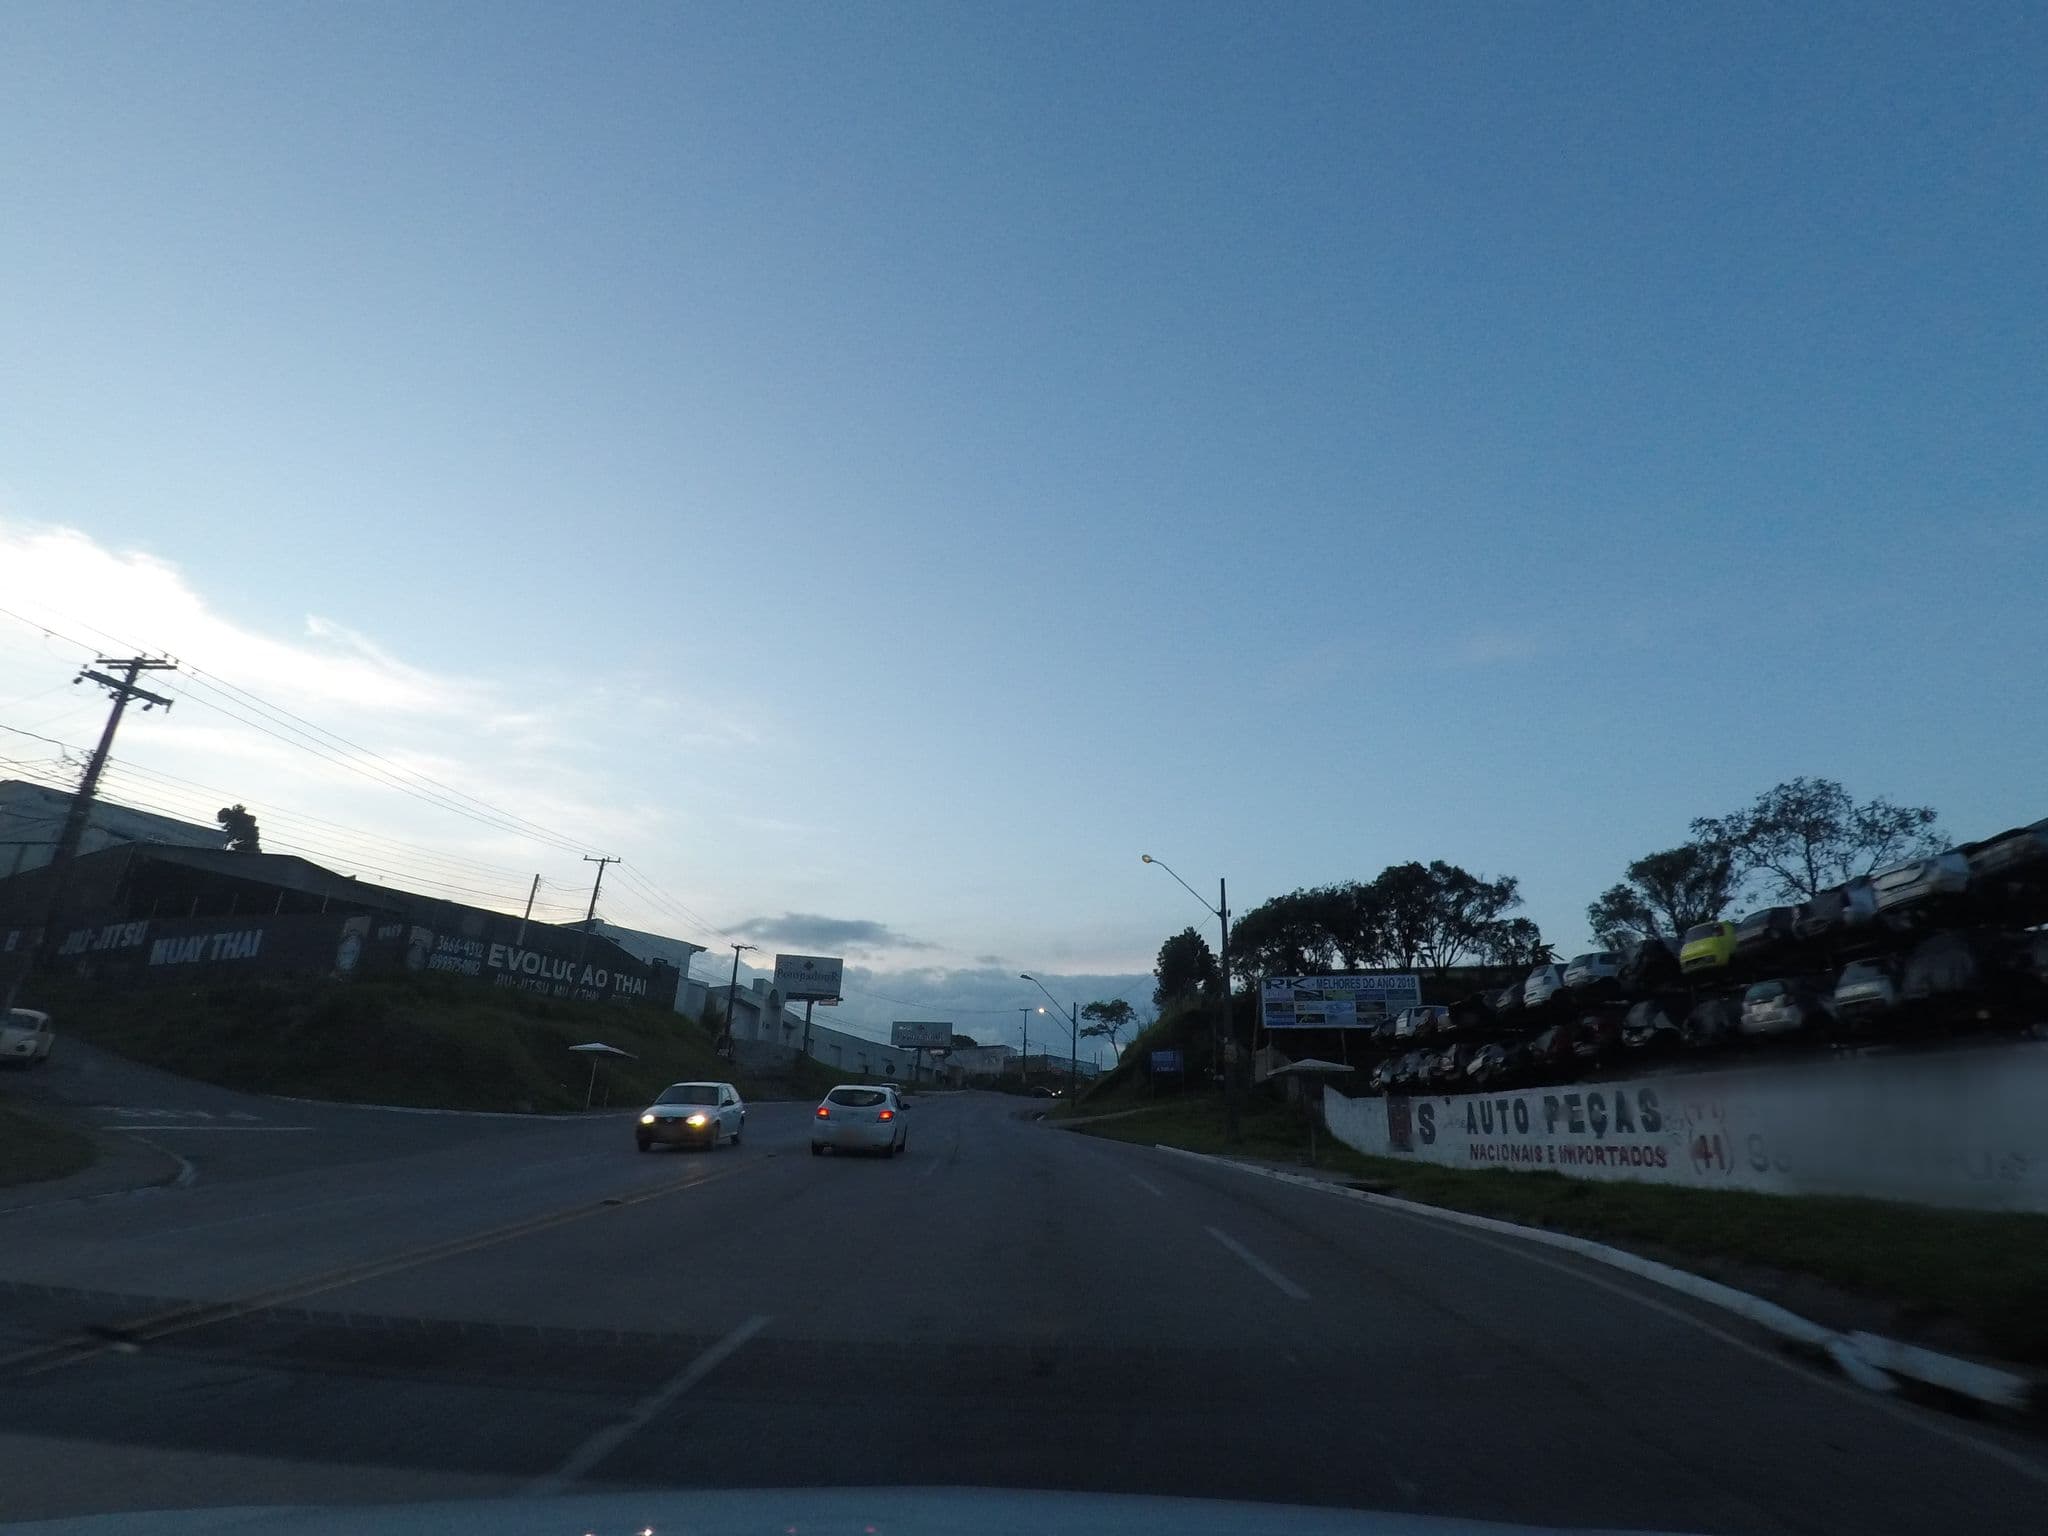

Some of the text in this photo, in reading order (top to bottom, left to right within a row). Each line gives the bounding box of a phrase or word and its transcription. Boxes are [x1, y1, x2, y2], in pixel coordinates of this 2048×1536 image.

[149, 929, 263, 965] MUAY THAI
[614, 973, 647, 997] THAI
[1265, 978, 1309, 990] RK
[1316, 977, 1361, 990] MELHORES
[1363, 977, 1375, 989] DO
[1377, 977, 1395, 989] ANO
[1467, 1098, 1529, 1135] AUTO
[1543, 1088, 1662, 1139] PEÇAS
[1470, 1143, 1668, 1168] NACIONAIS E IMPORTADOS
